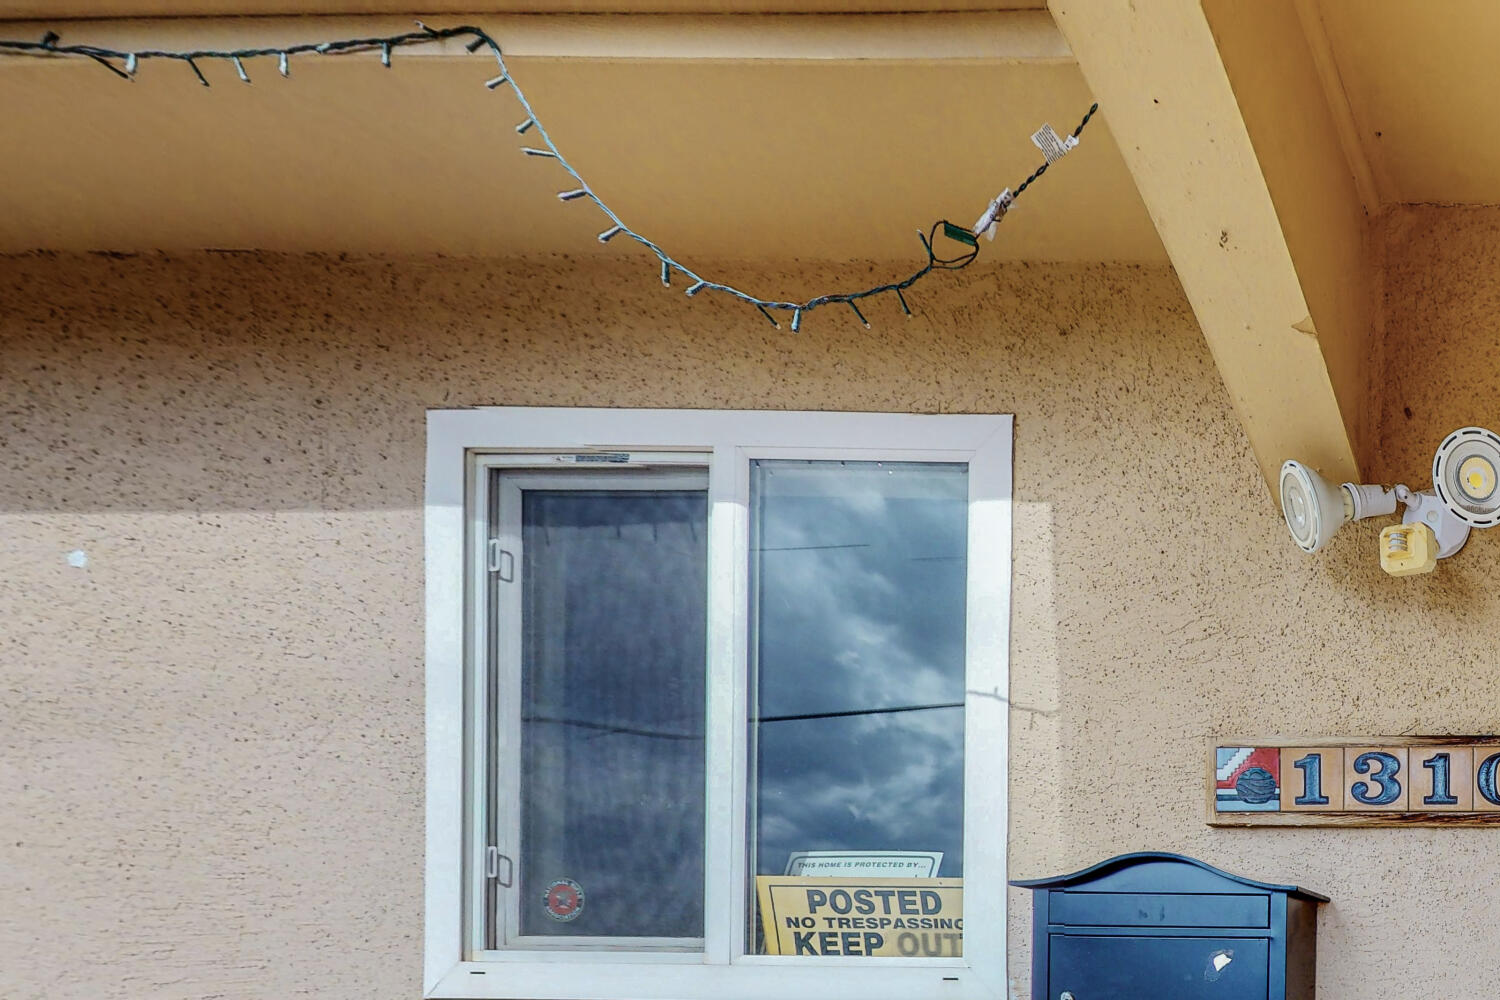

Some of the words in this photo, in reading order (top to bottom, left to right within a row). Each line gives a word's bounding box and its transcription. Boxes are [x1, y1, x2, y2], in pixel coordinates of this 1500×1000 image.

[806, 889, 942, 915] POSTED
[786, 917, 816, 929] NO
[794, 931, 884, 956] KEEP
[897, 932, 963, 956] OUT
